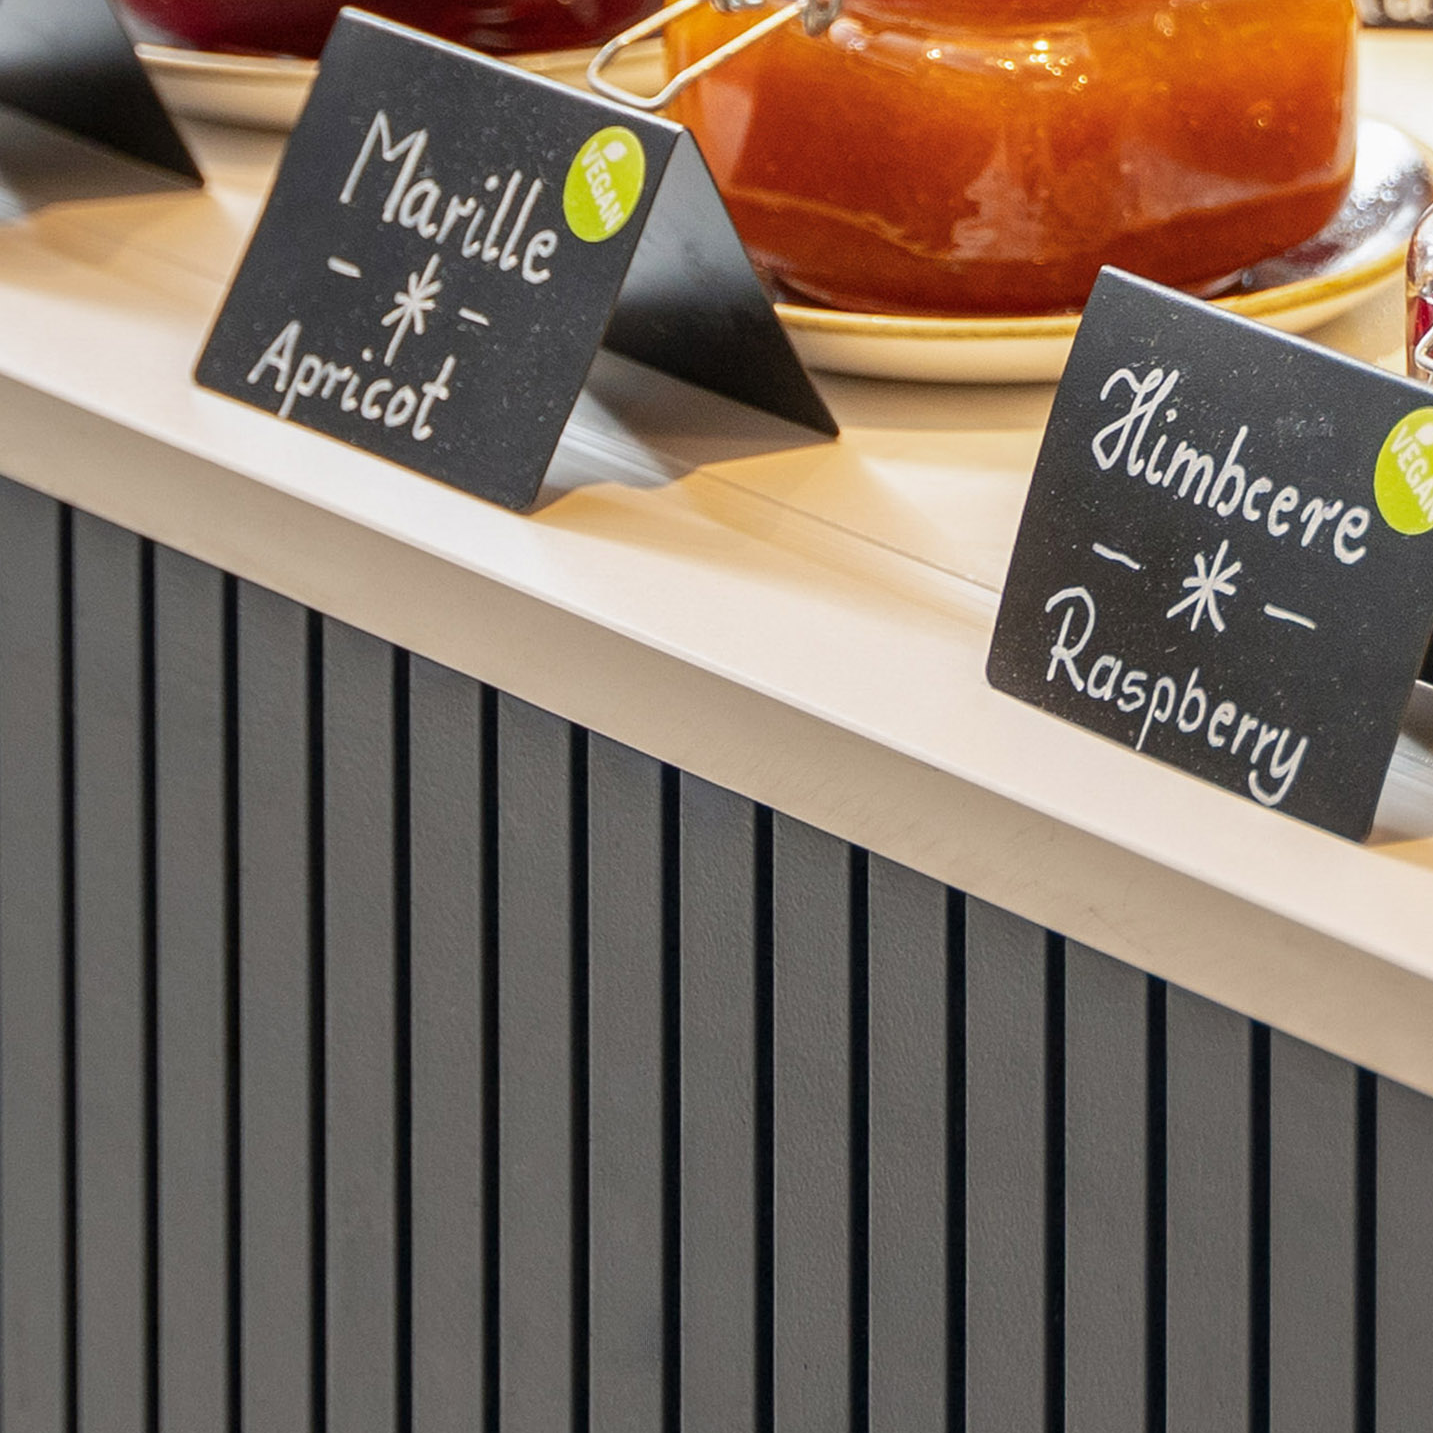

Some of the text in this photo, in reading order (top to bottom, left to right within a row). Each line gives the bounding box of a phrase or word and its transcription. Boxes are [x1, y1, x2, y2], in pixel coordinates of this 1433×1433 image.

[339, 110, 558, 284] Marille
[582, 140, 624, 232] VEGAN
[246, 320, 456, 441] Apricot
[1044, 585, 1309, 807] Raspberry
